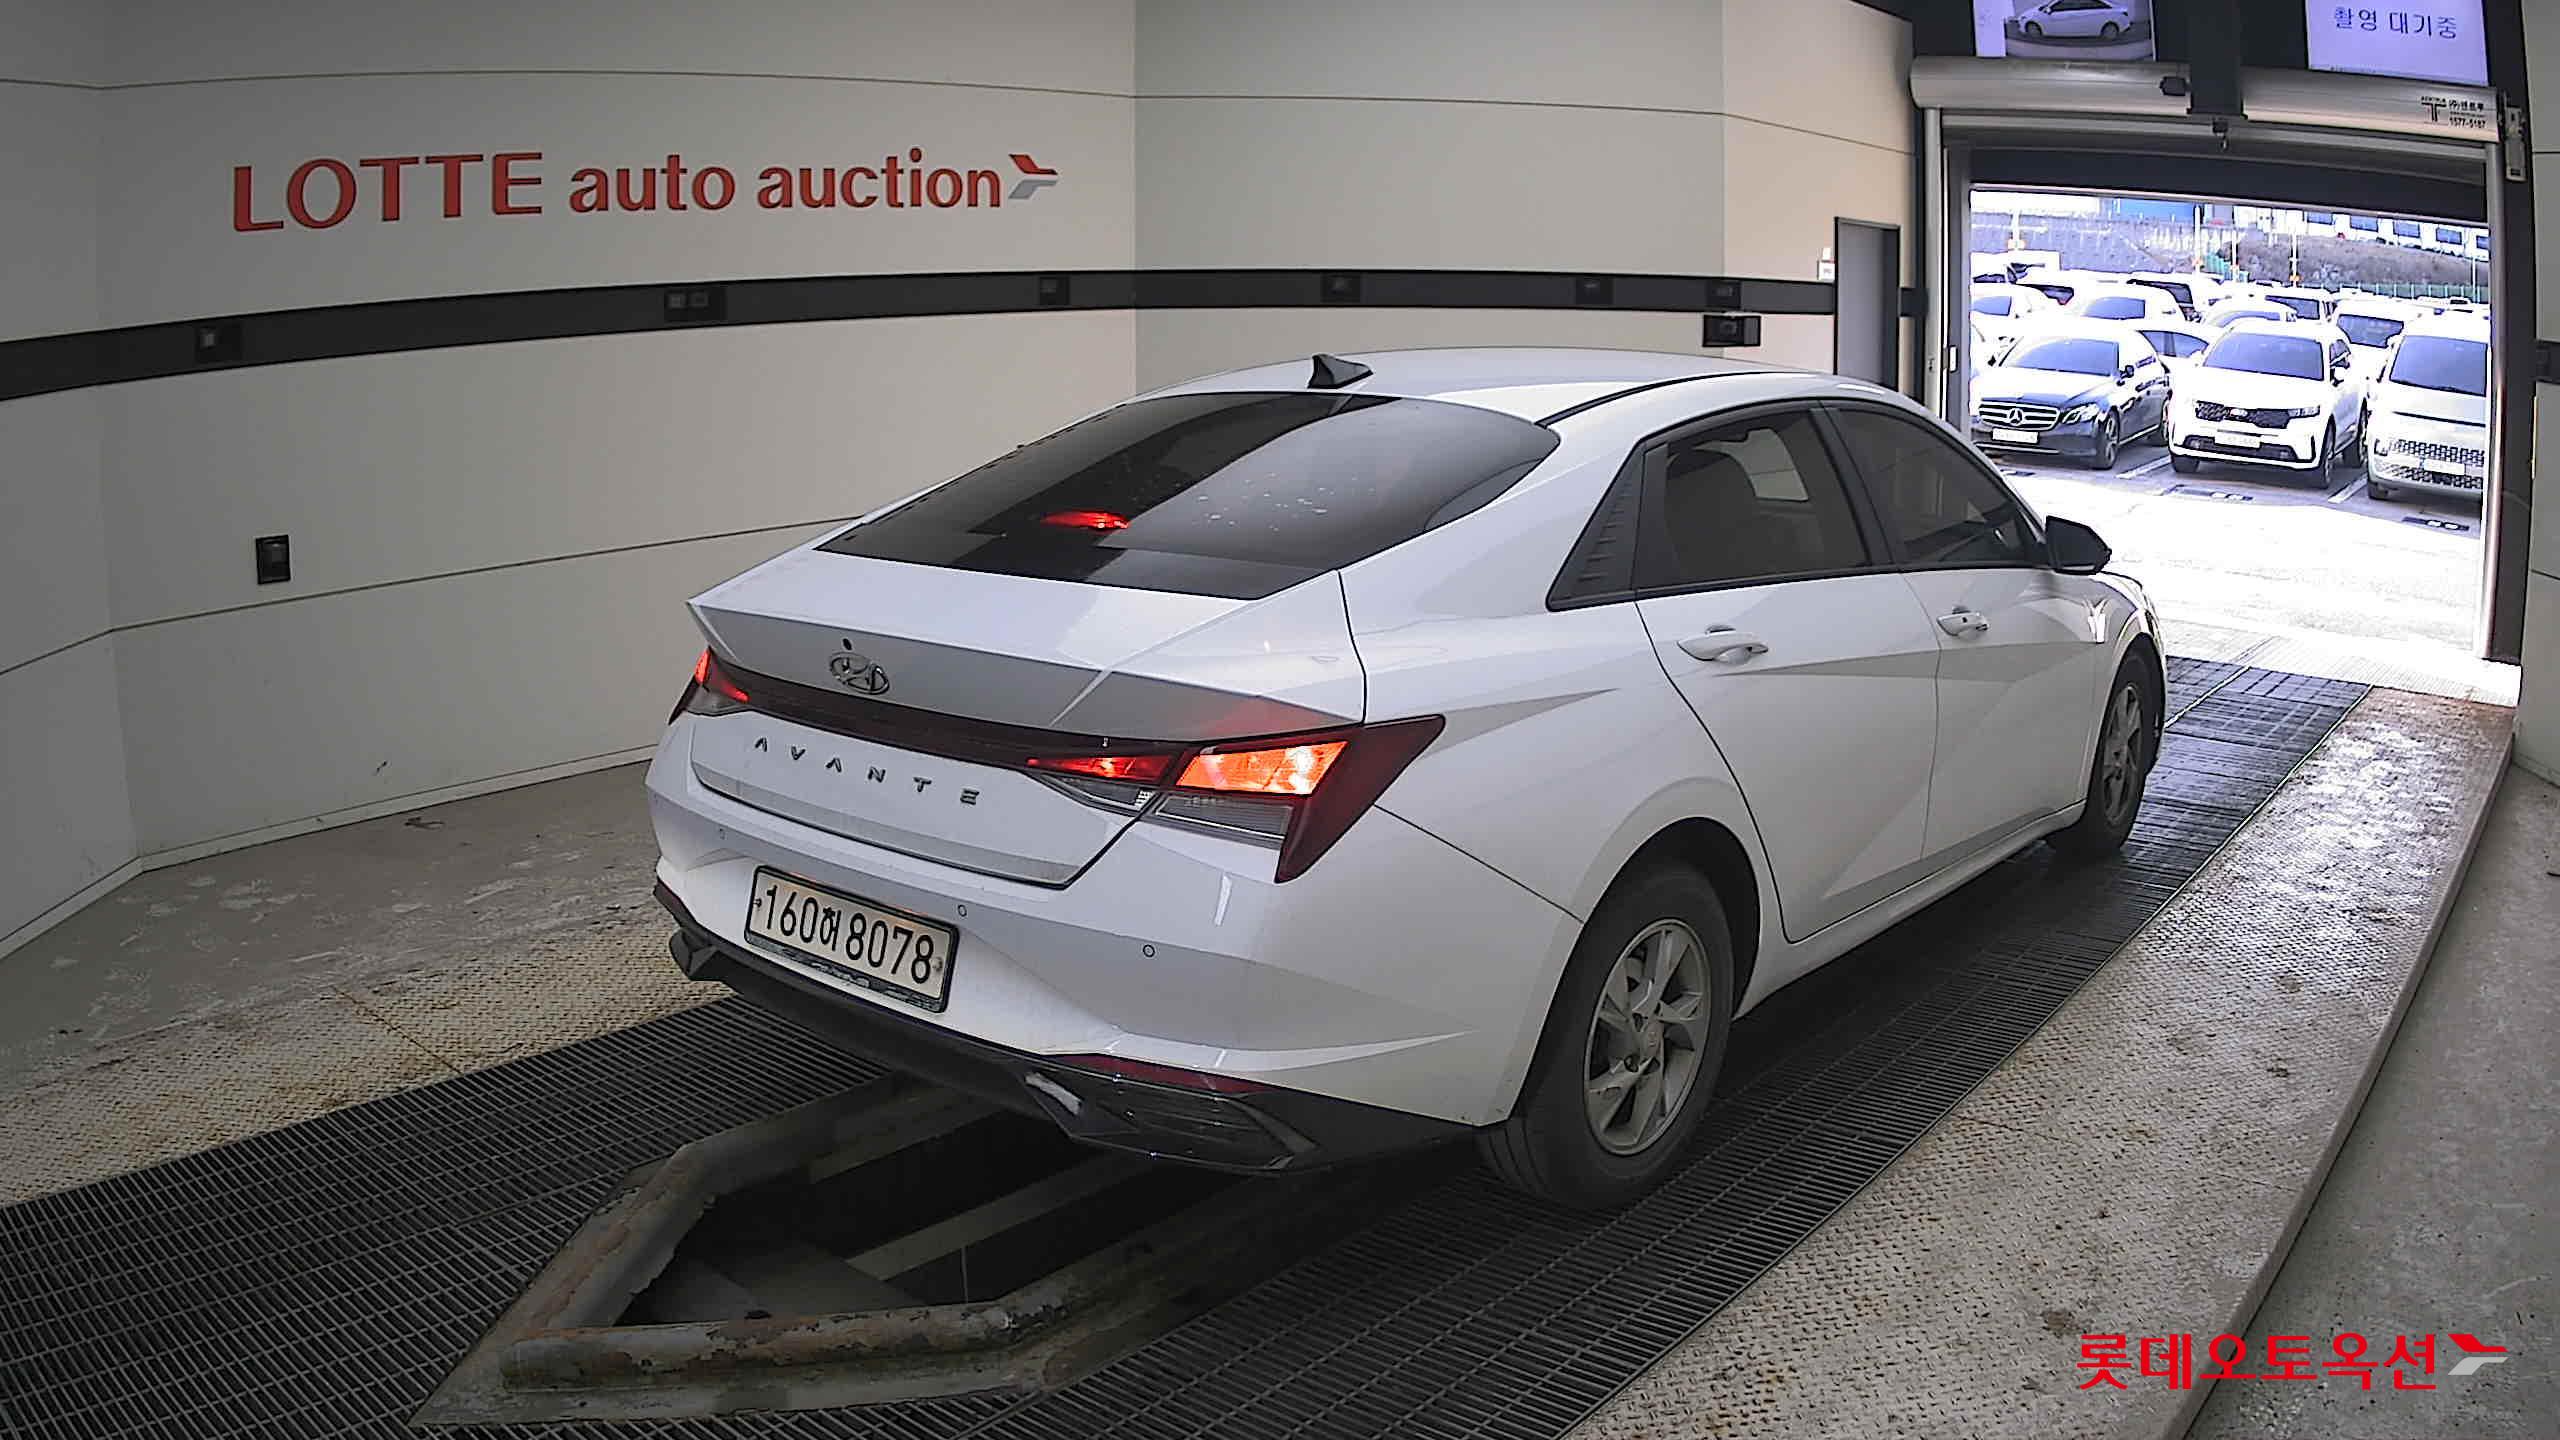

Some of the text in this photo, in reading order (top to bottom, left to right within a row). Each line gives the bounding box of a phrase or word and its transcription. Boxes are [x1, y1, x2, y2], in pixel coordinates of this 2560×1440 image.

[2335, 7, 2457, 39] 촬영 대기중
[233, 147, 1002, 232] LOTTE auto auction
[755, 738, 979, 805] AVANTE
